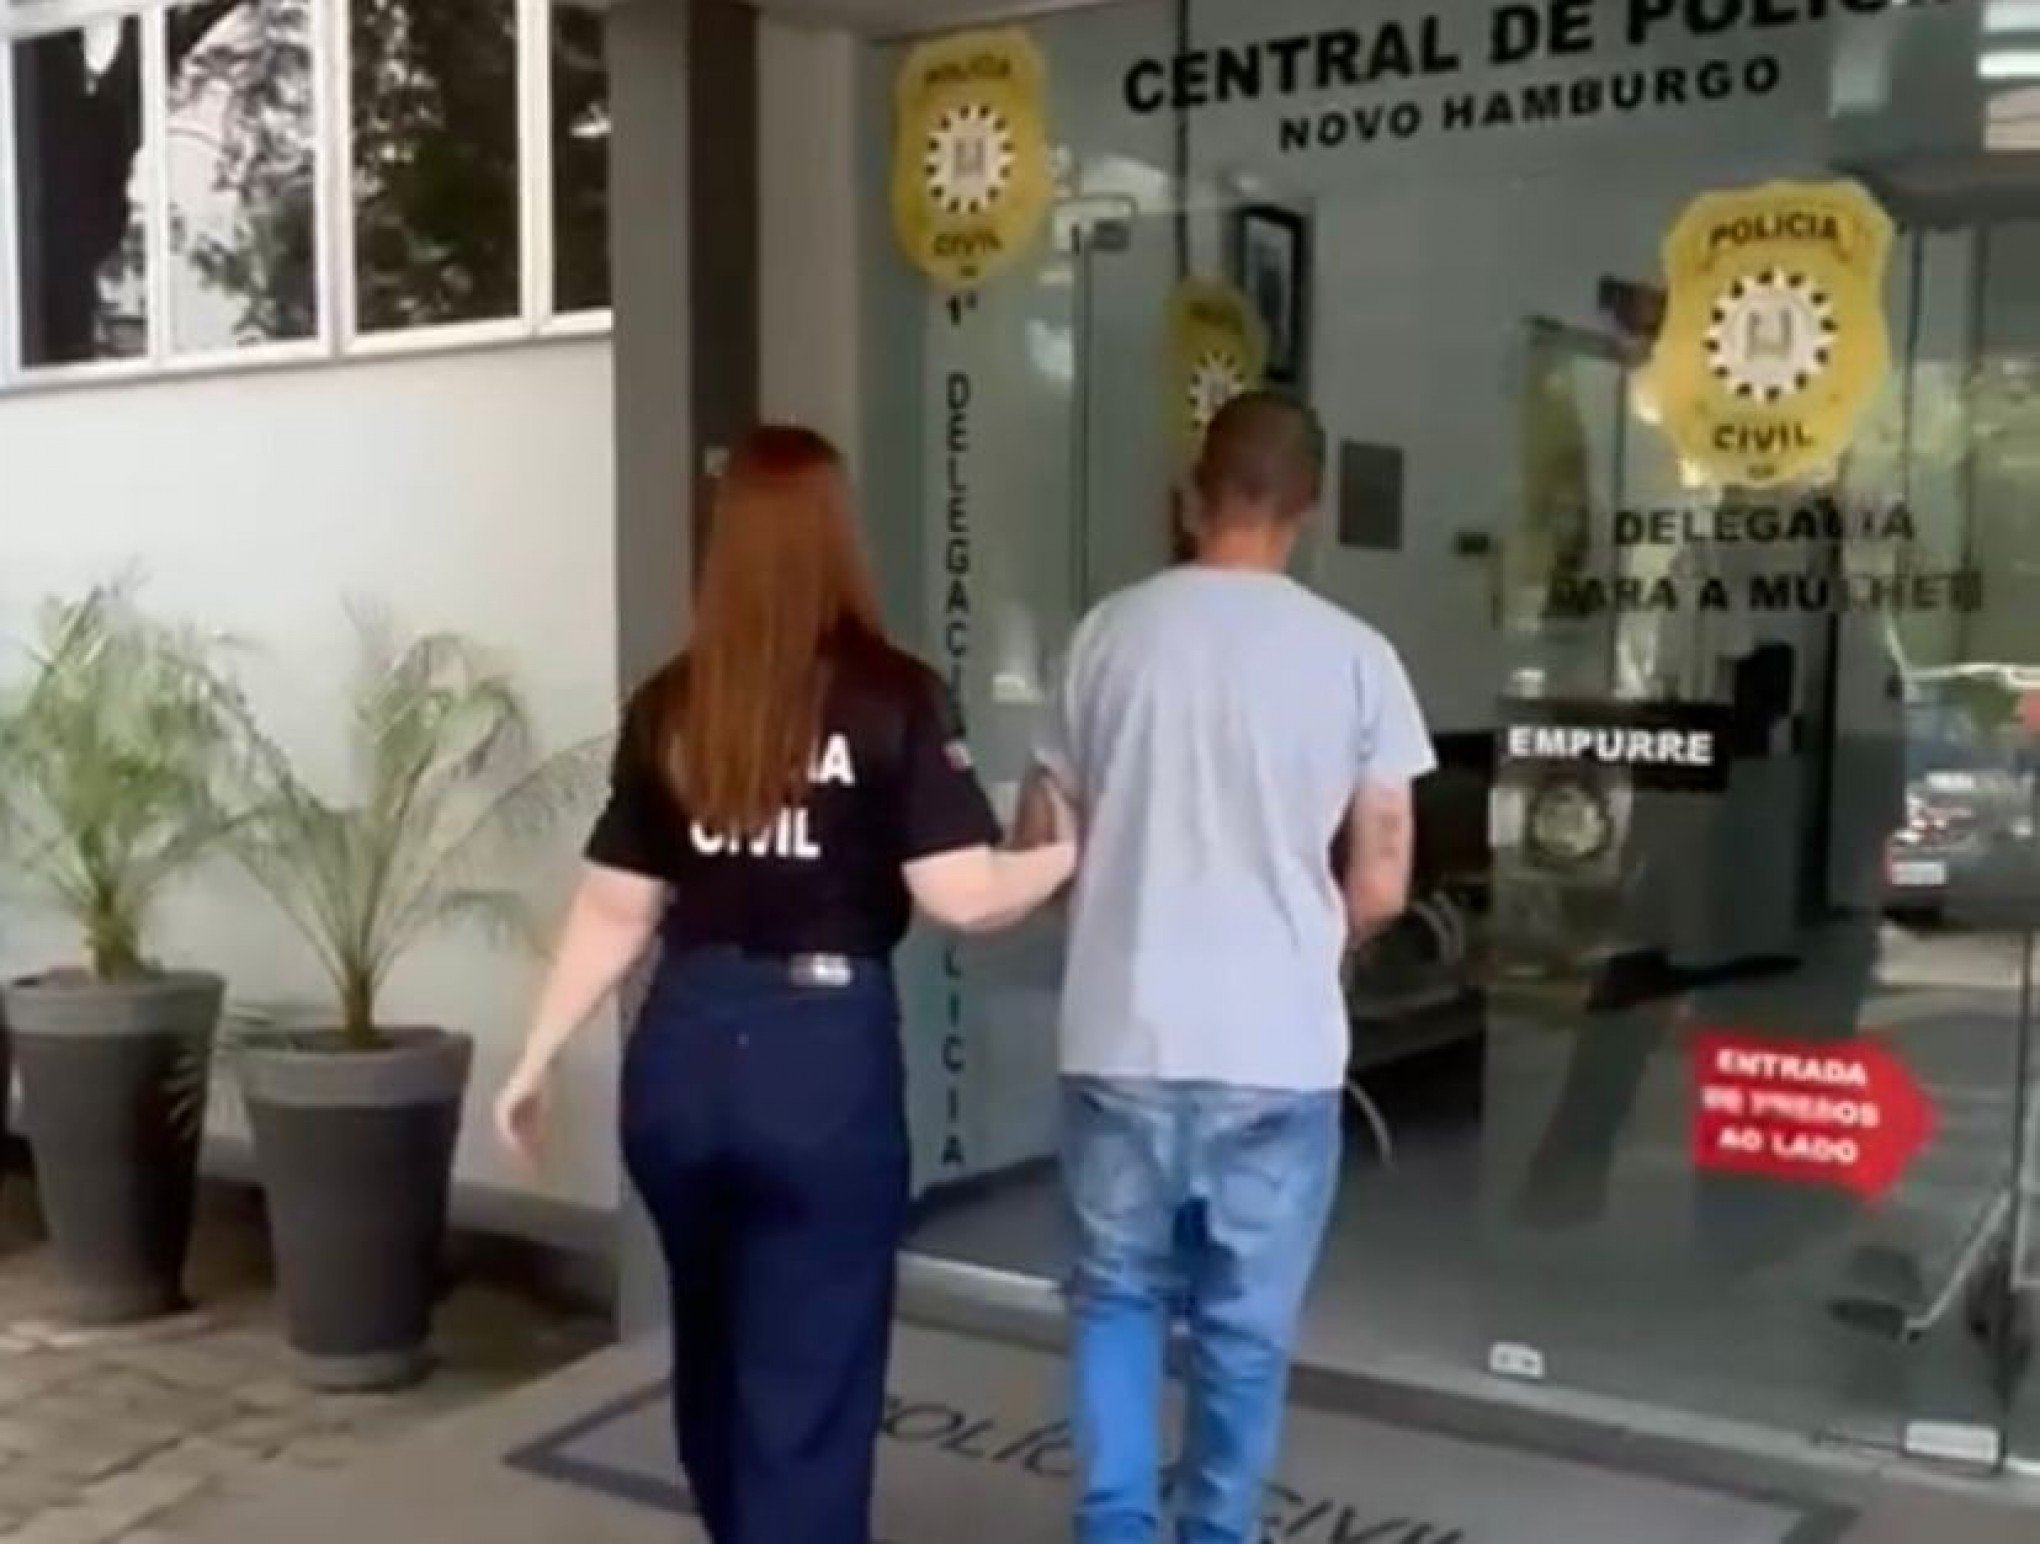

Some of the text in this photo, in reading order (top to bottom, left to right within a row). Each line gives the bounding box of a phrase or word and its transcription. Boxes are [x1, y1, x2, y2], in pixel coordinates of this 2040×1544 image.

[1123, 14, 1460, 114] CENTRAL
[1489, 2, 1594, 63] DE
[1278, 57, 1781, 152] NOVO HAMBURGO
[1712, 420, 1816, 452] CIVIL
[1699, 577, 1730, 612] A
[1508, 725, 1714, 766] EMPURRE
[1716, 1048, 1869, 1088] ENTRADA
